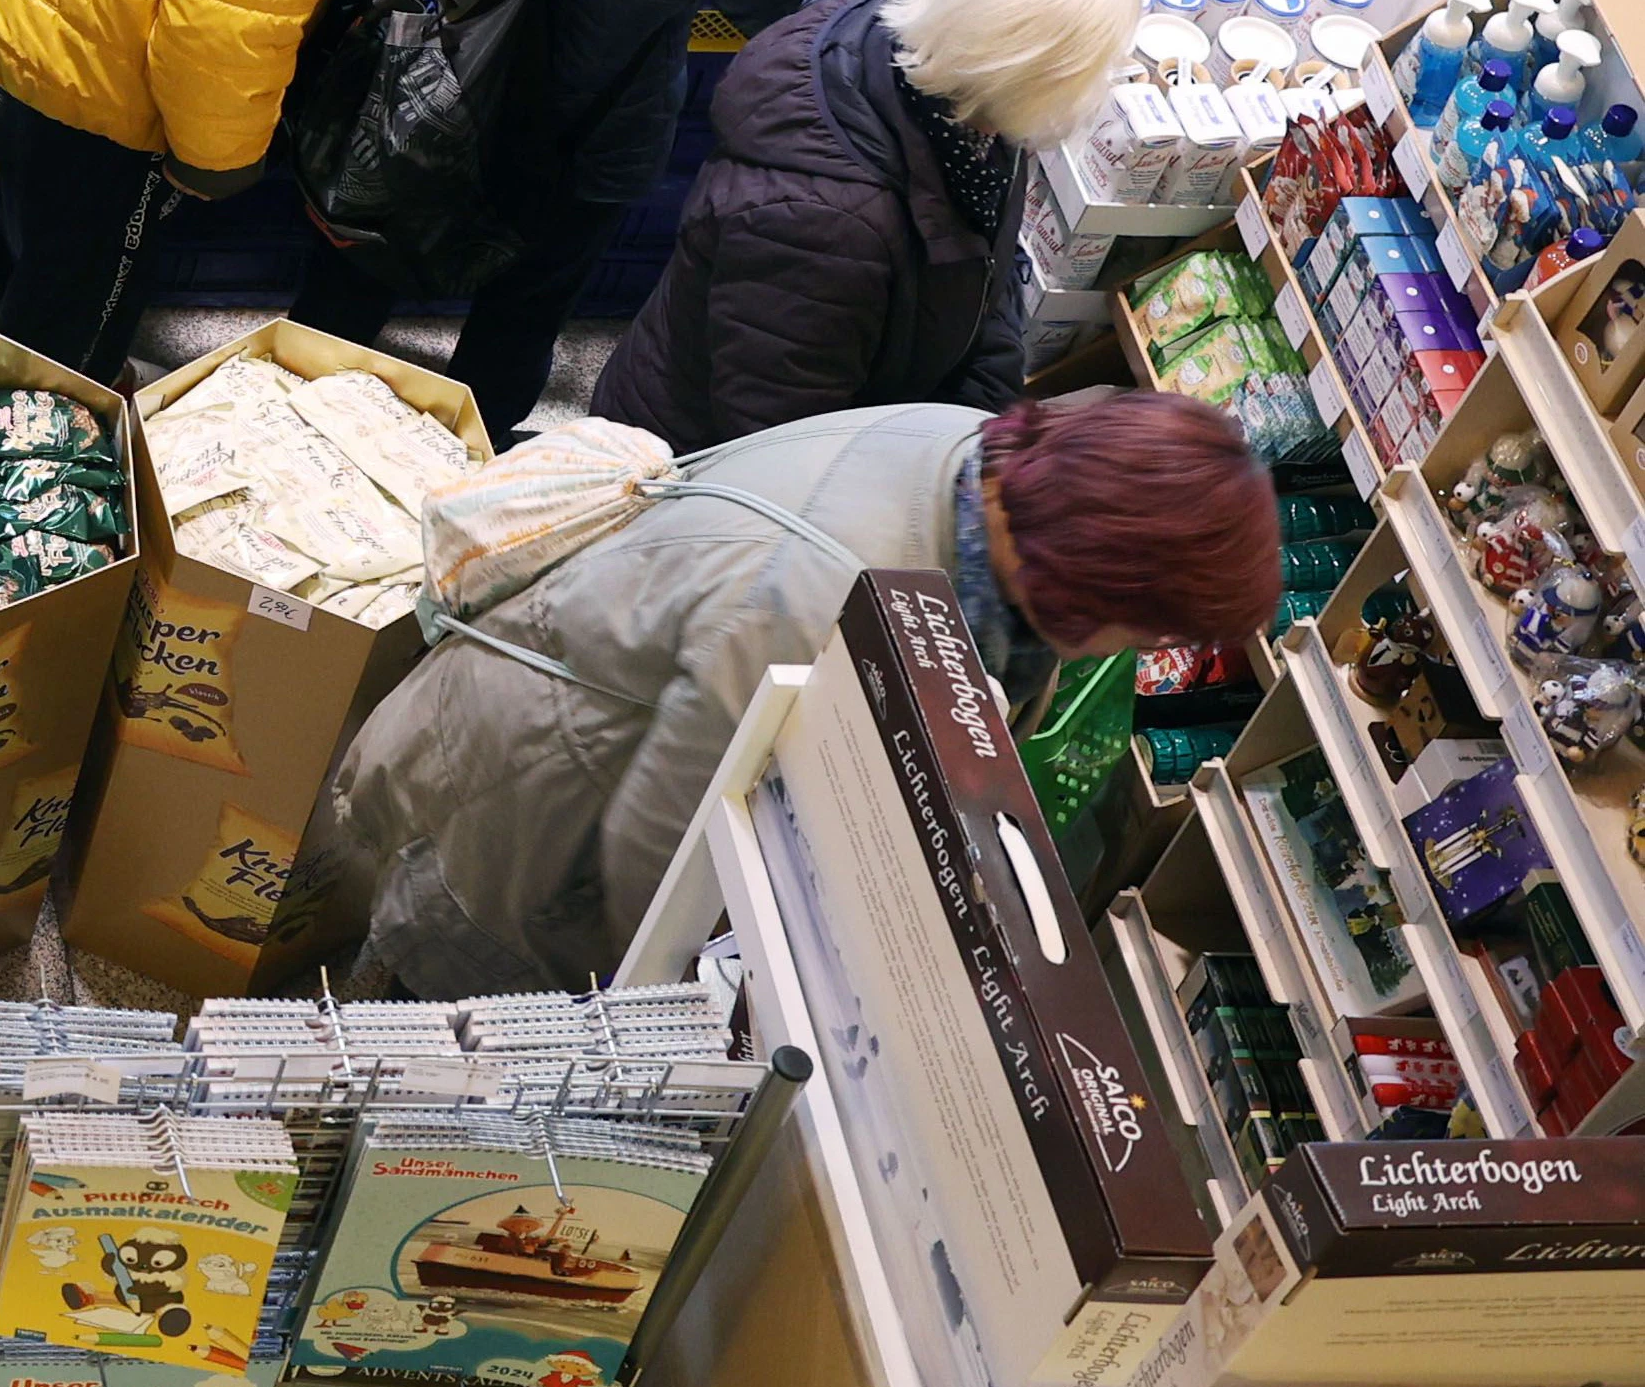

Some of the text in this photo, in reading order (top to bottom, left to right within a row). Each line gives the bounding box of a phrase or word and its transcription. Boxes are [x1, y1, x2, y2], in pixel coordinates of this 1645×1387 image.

[890, 587, 933, 672] Light Arch
[915, 590, 999, 760] Lichterbogen
[892, 728, 1050, 1123] Lichterbogen Light Arch
[1080, 1067, 1116, 1137] ORIGINAL
[1095, 1064, 1142, 1141] SAICO
[372, 1160, 519, 1183] Sandmännchen
[399, 1156, 454, 1170] Unser
[1359, 1148, 1583, 1194] Lichterbogen
[1373, 1189, 1482, 1217] Light Arch
[31, 1205, 270, 1236] Ausmalkalender
[559, 1225, 590, 1241] LOTSE
[1504, 1239, 1645, 1262] Lichter
[485, 1363, 536, 1381] 2024
